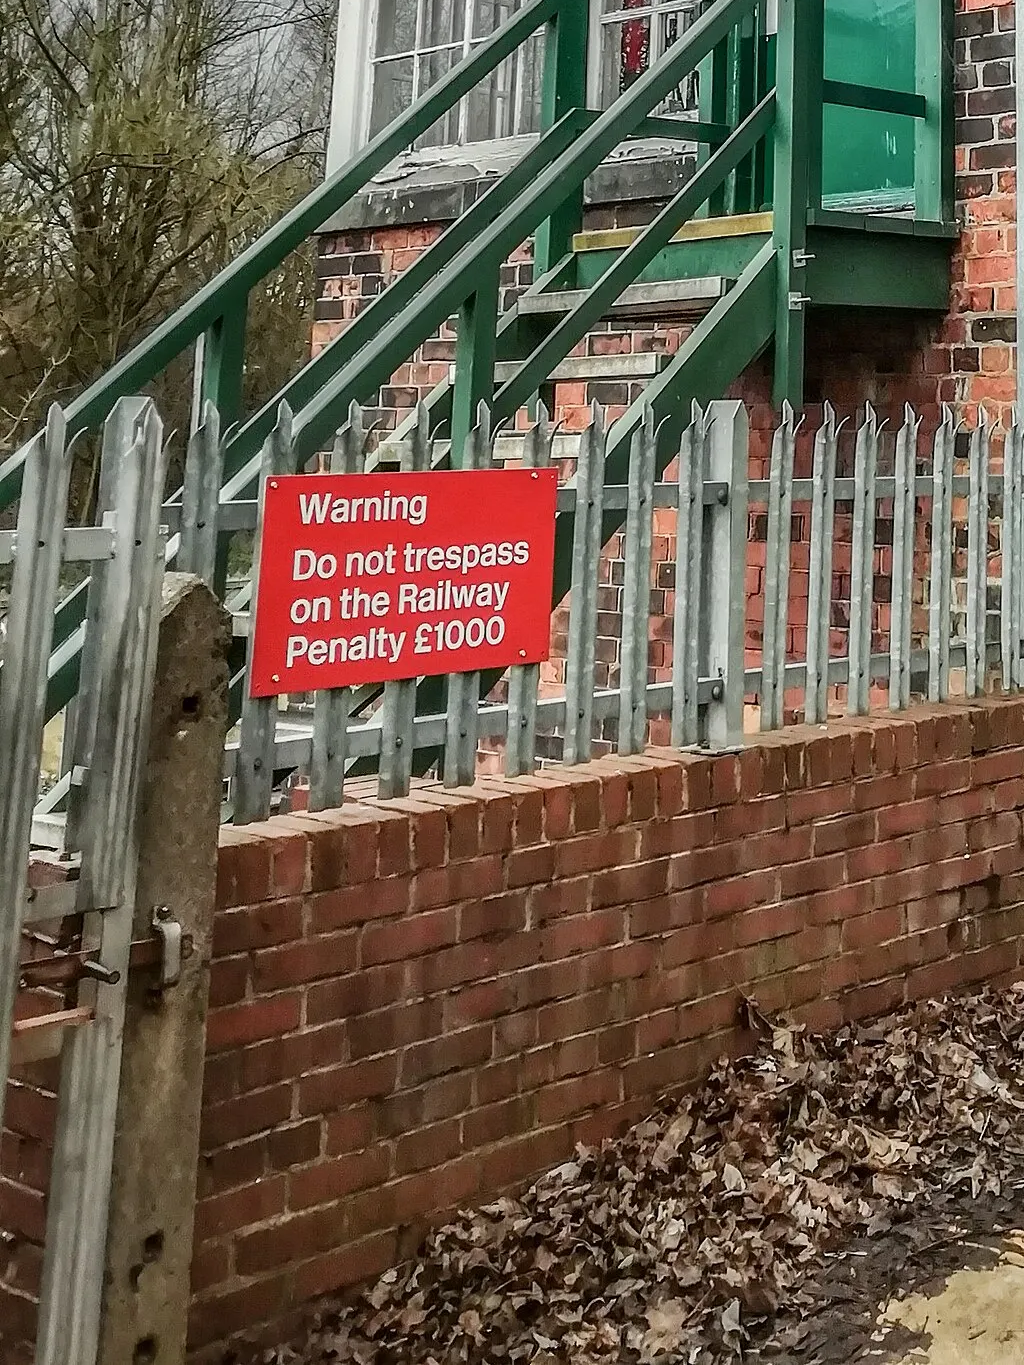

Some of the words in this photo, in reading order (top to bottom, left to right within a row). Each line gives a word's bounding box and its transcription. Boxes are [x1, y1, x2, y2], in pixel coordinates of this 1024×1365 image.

[298, 490, 428, 525] Warning
[292, 549, 337, 581] Do
[345, 543, 397, 577] not
[403, 540, 530, 574] trespass
[290, 595, 331, 625] on
[339, 587, 390, 620] the
[397, 579, 510, 615] Railway
[285, 627, 407, 668] Penalty
[413, 615, 506, 654] £1000
